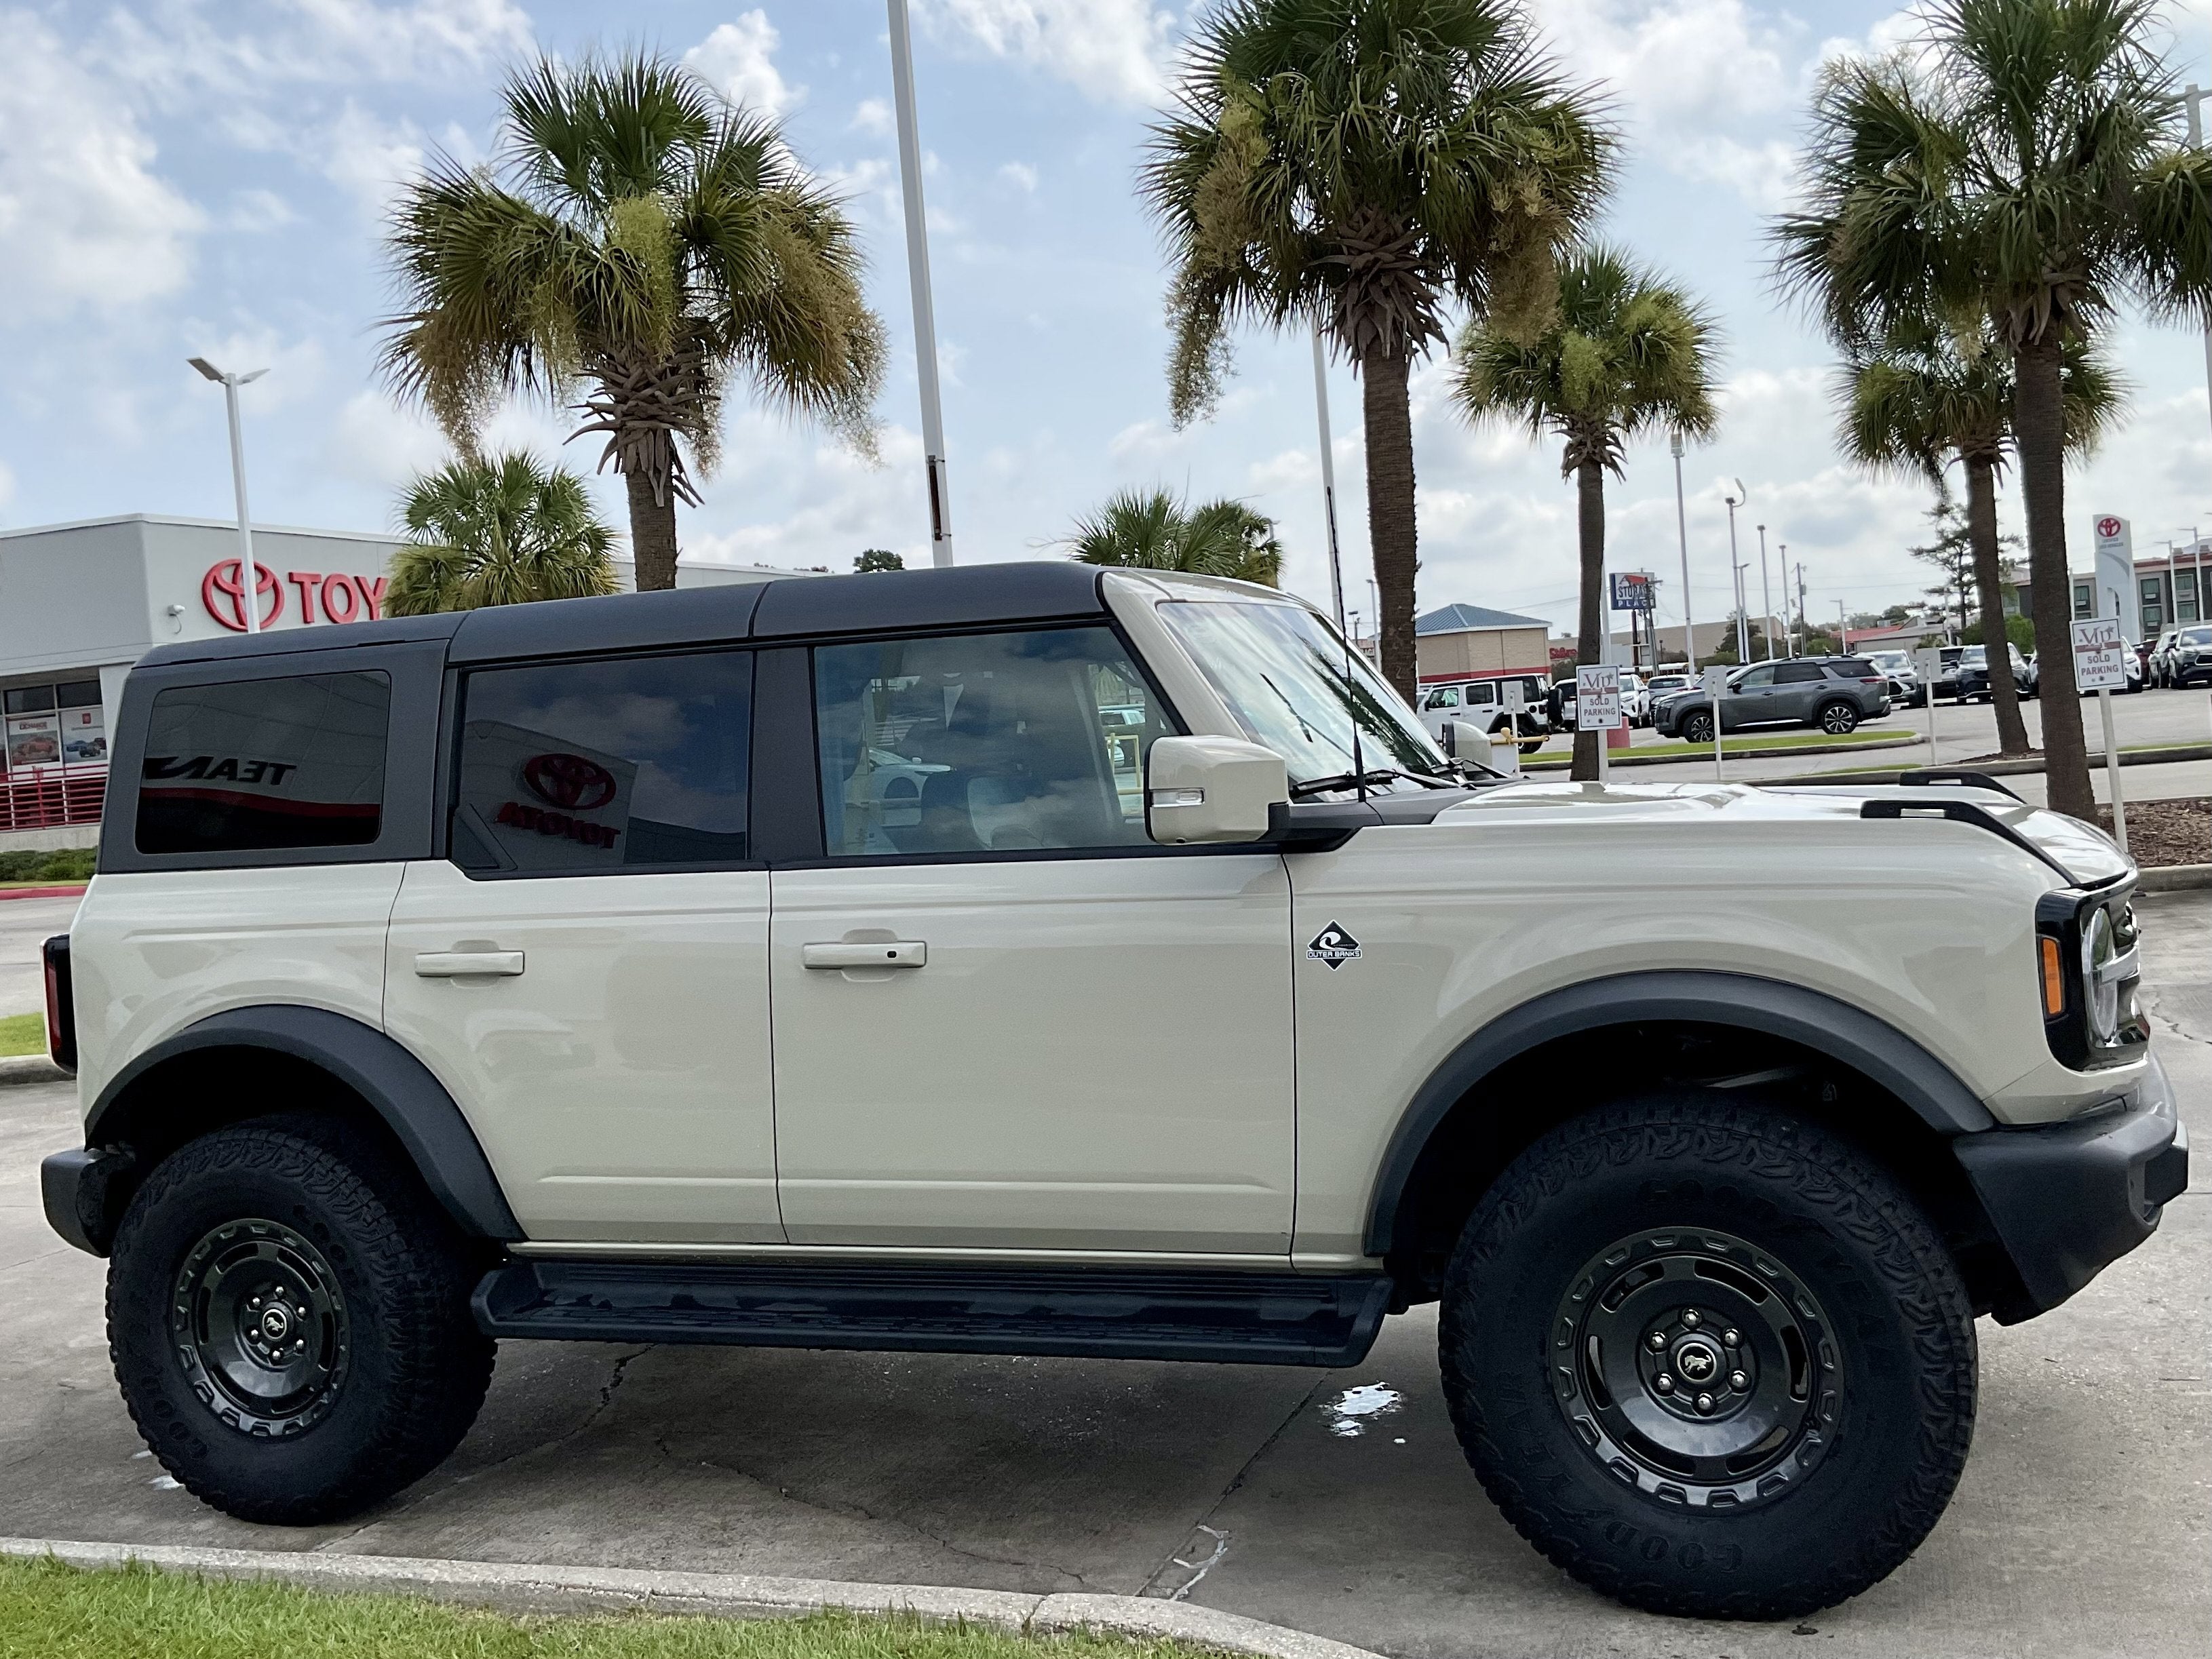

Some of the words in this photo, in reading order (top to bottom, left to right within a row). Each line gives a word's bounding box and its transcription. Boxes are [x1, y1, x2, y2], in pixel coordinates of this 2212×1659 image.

[2087, 653, 2110, 664] SOLD
[2081, 664, 2119, 676] PARKING
[1589, 697, 1610, 706] SOLD
[1584, 707, 1616, 716] PARKING
